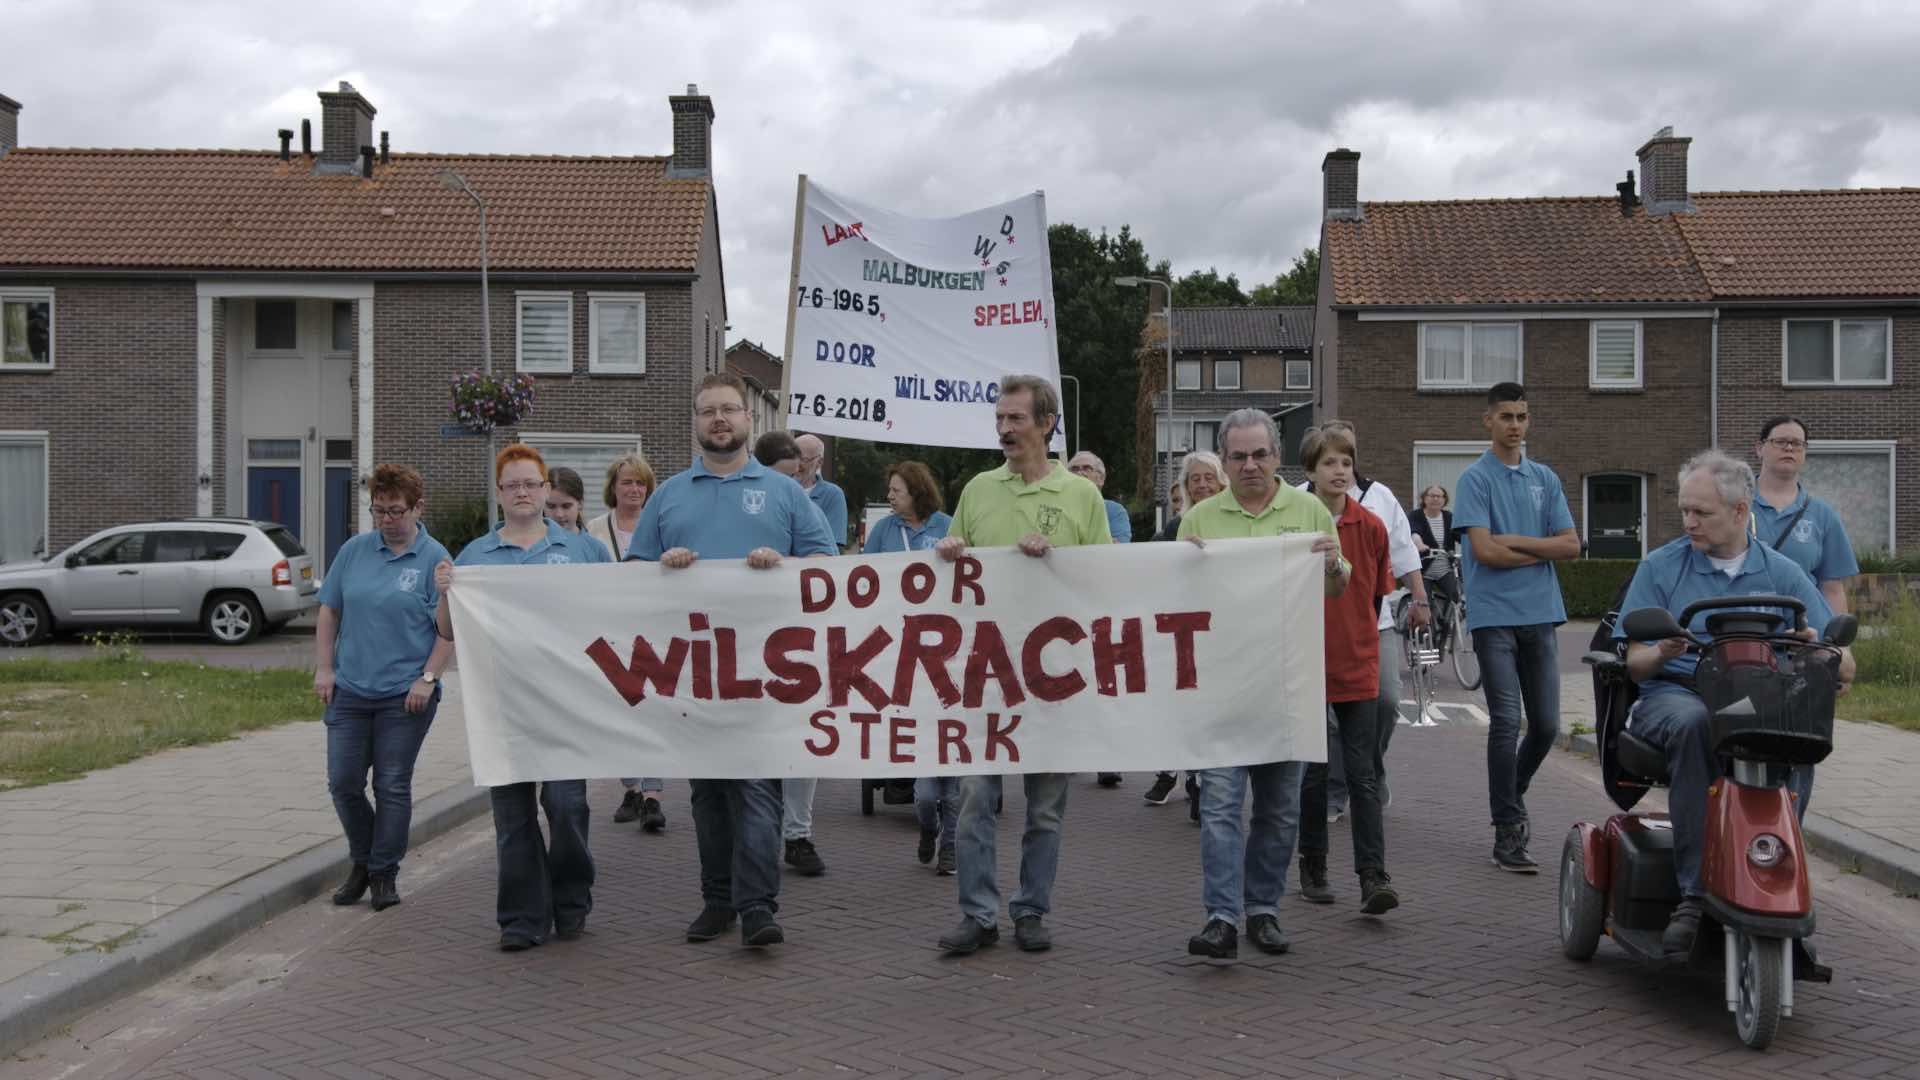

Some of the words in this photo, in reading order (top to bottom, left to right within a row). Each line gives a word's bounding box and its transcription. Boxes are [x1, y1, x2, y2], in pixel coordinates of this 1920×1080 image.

[863, 259, 985, 291] MALBURGEN
[816, 339, 876, 367] DOOR
[800, 556, 986, 613] DOOR
[804, 711, 1022, 764] STERK
